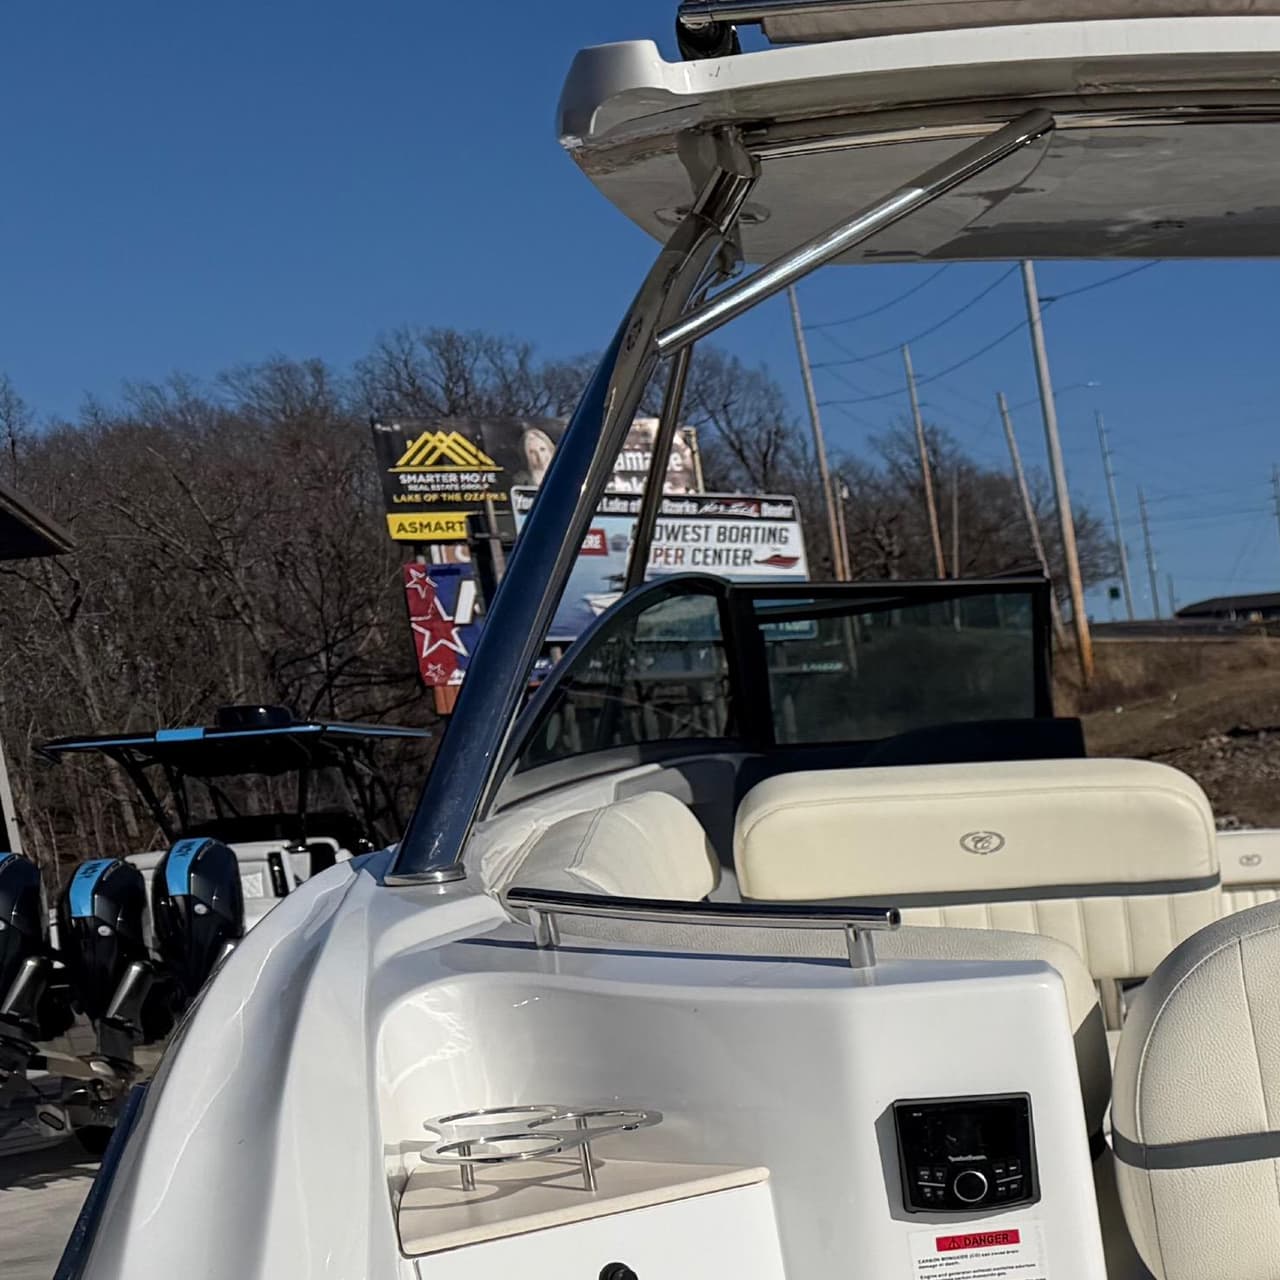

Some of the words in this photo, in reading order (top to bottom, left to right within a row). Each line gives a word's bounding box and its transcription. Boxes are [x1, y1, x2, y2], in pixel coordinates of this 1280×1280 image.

[398, 473, 458, 484] SMARTER
[716, 525, 790, 545] BOATING
[651, 547, 685, 566] PER
[691, 549, 753, 567] CENTER
[963, 1233, 1010, 1247] DANGER
